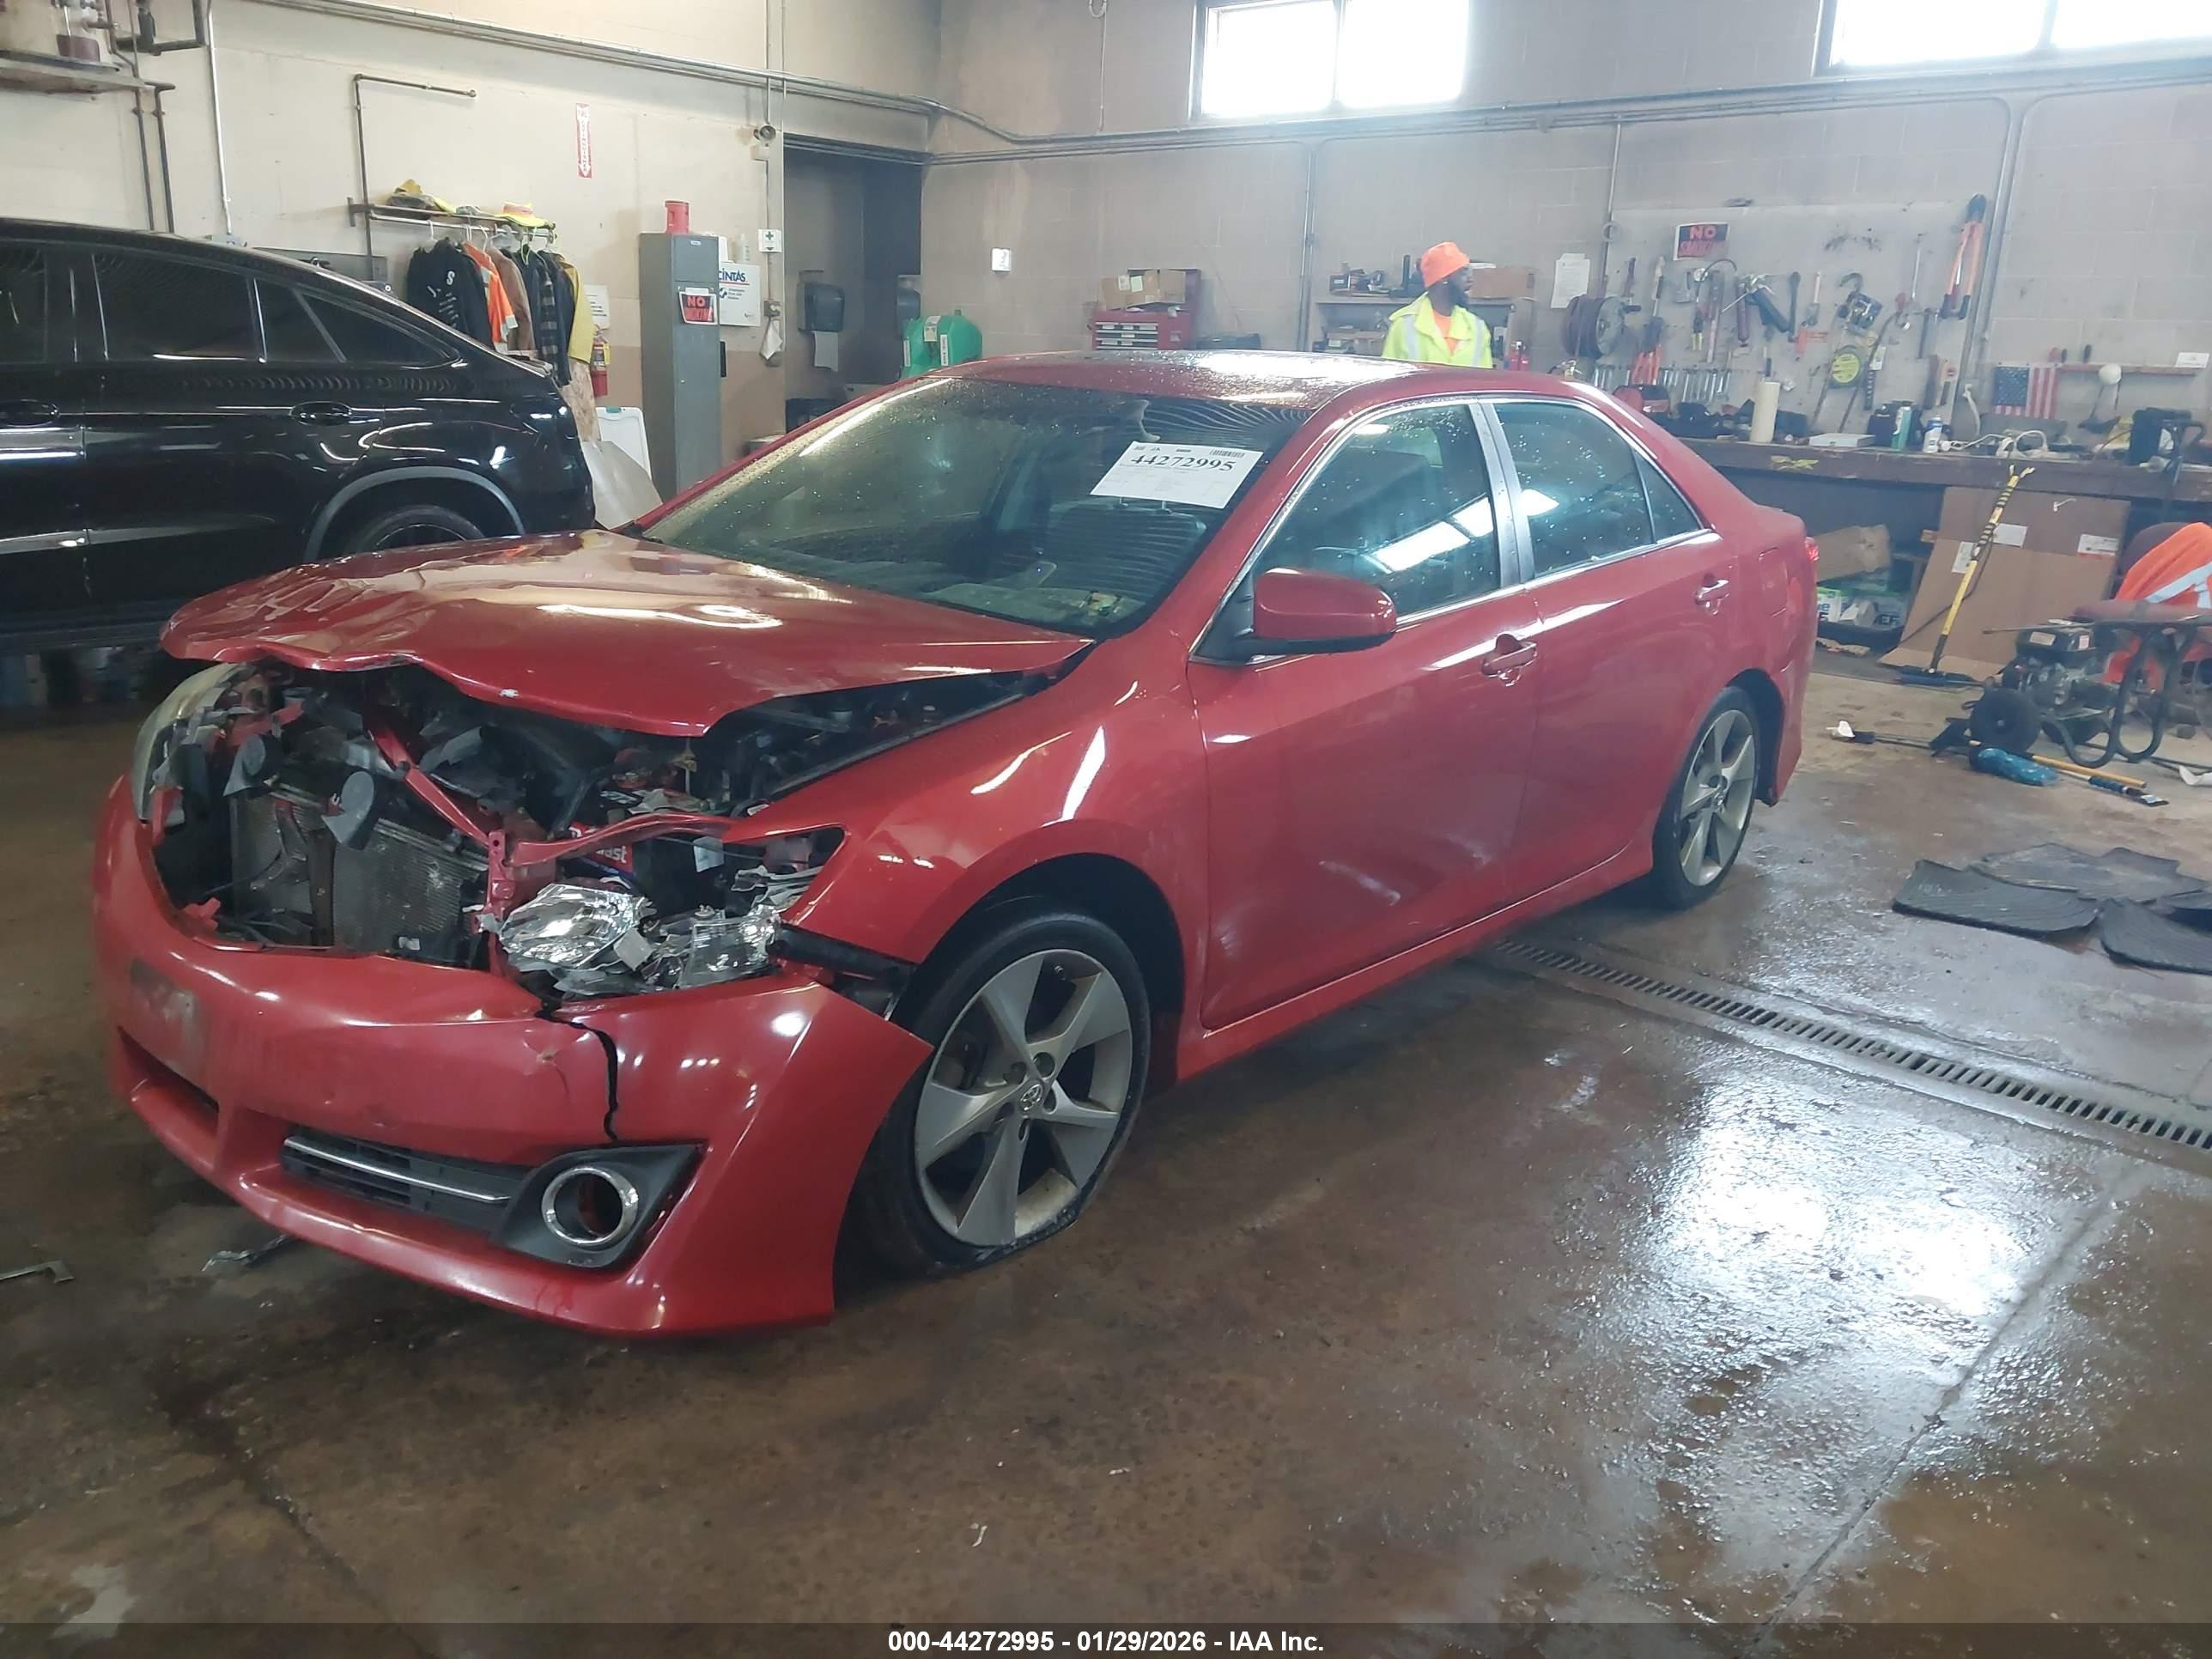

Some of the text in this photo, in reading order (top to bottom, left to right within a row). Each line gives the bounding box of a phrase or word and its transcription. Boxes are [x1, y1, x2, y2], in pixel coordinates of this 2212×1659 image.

[1689, 225, 1717, 240] NO
[687, 295, 706, 307] NO
[1131, 454, 1237, 471] 44272995
